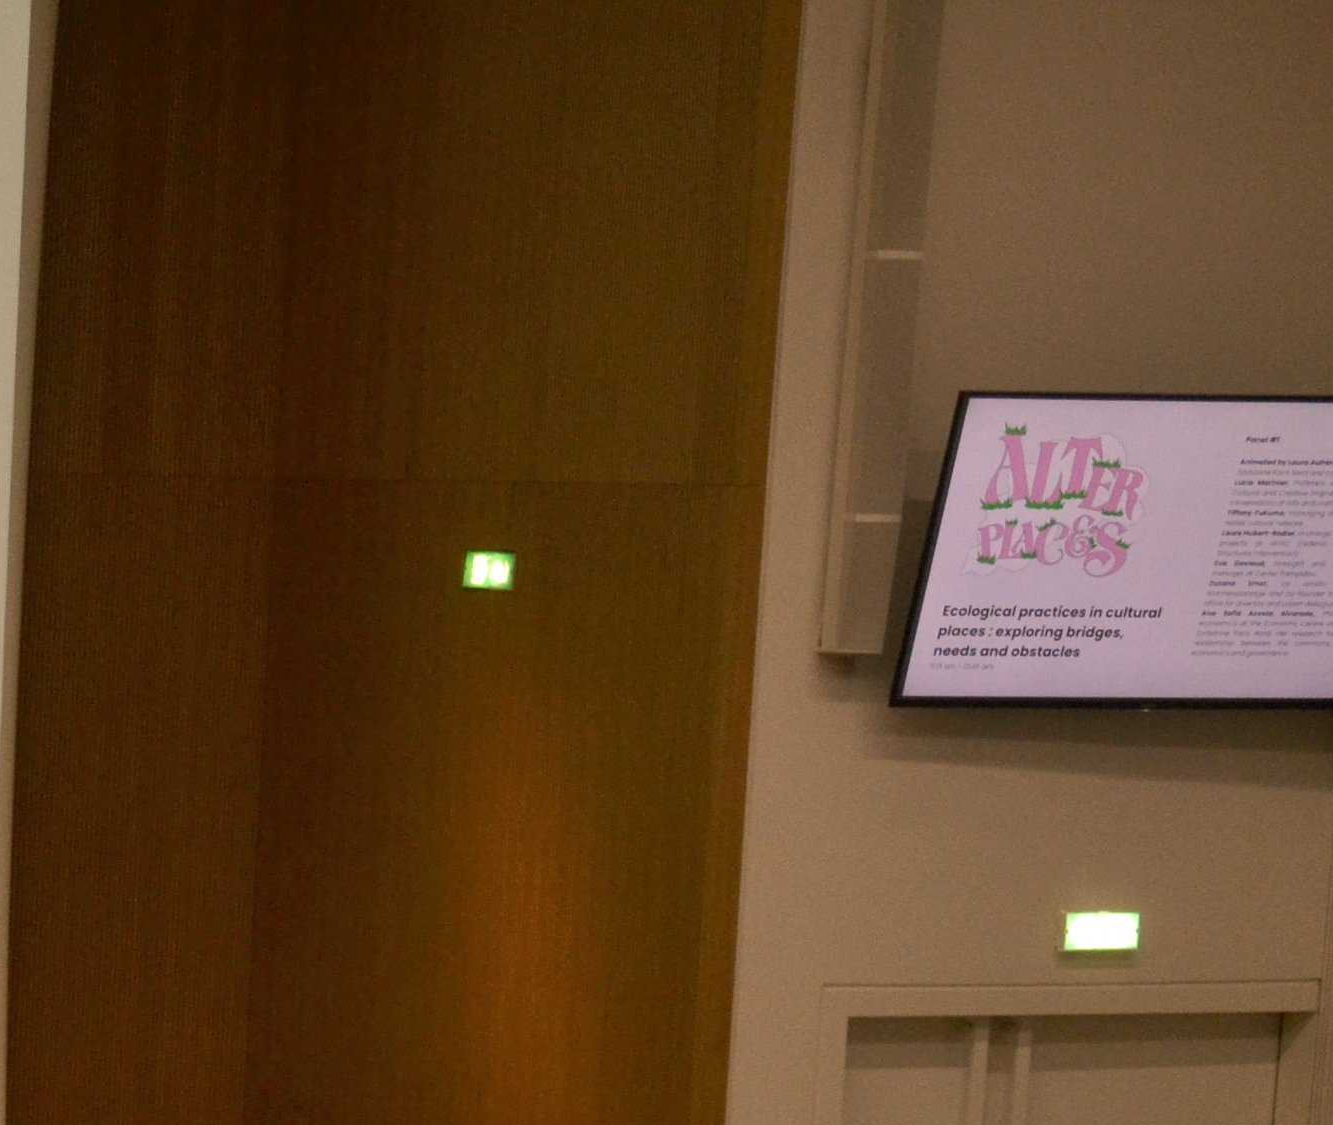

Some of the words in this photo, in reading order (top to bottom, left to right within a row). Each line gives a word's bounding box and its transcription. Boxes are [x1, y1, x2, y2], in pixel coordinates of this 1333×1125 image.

[942, 605, 1016, 620] Ecological
[1018, 605, 1087, 620] practices
[1089, 605, 1103, 618] in
[1104, 606, 1163, 619] cultural
[937, 625, 985, 640] places
[995, 625, 1064, 642] exploring
[1065, 625, 1124, 642] bridges,
[932, 644, 977, 657] needs
[979, 645, 1008, 657] and
[1011, 644, 1081, 658] obstacles
